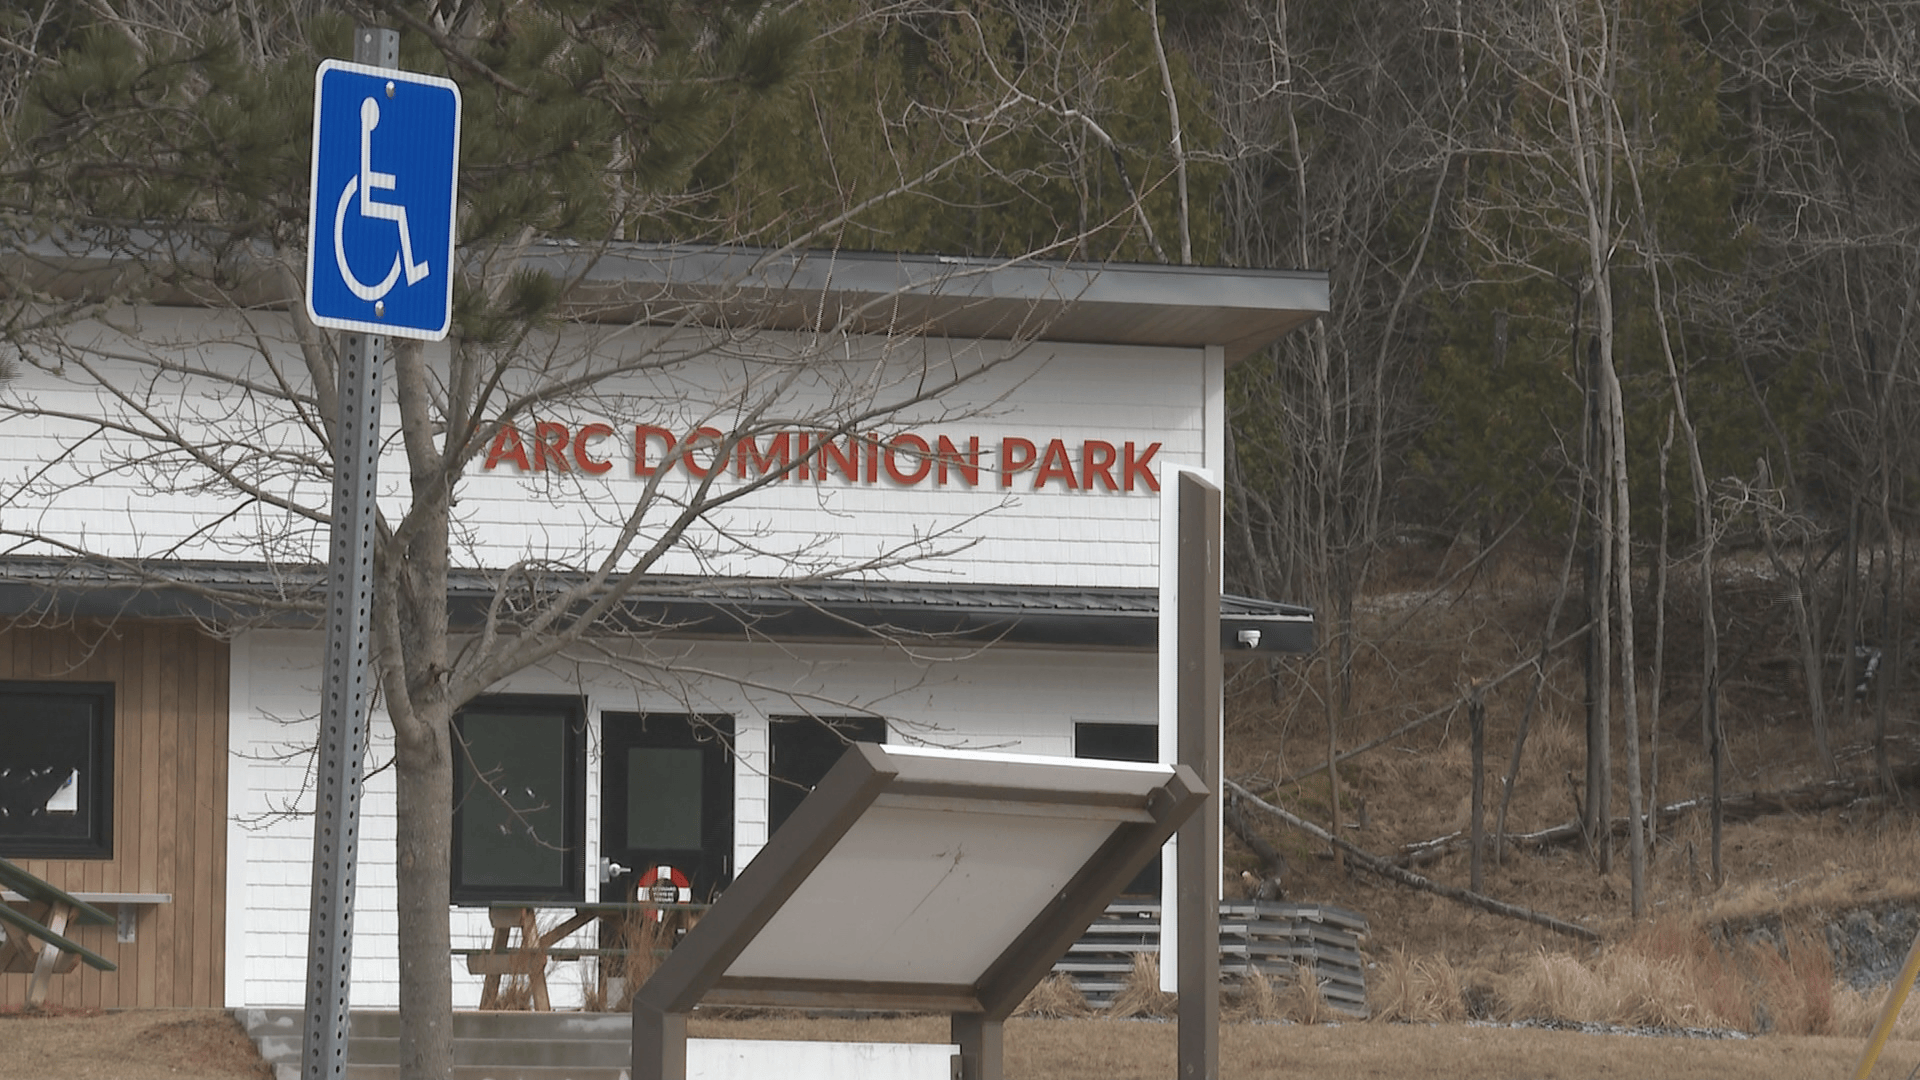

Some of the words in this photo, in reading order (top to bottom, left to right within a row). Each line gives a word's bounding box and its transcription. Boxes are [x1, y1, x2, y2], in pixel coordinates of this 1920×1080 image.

[464, 420, 615, 475] ARC
[634, 424, 980, 486] DOMINION
[1001, 436, 1162, 492] PARK
